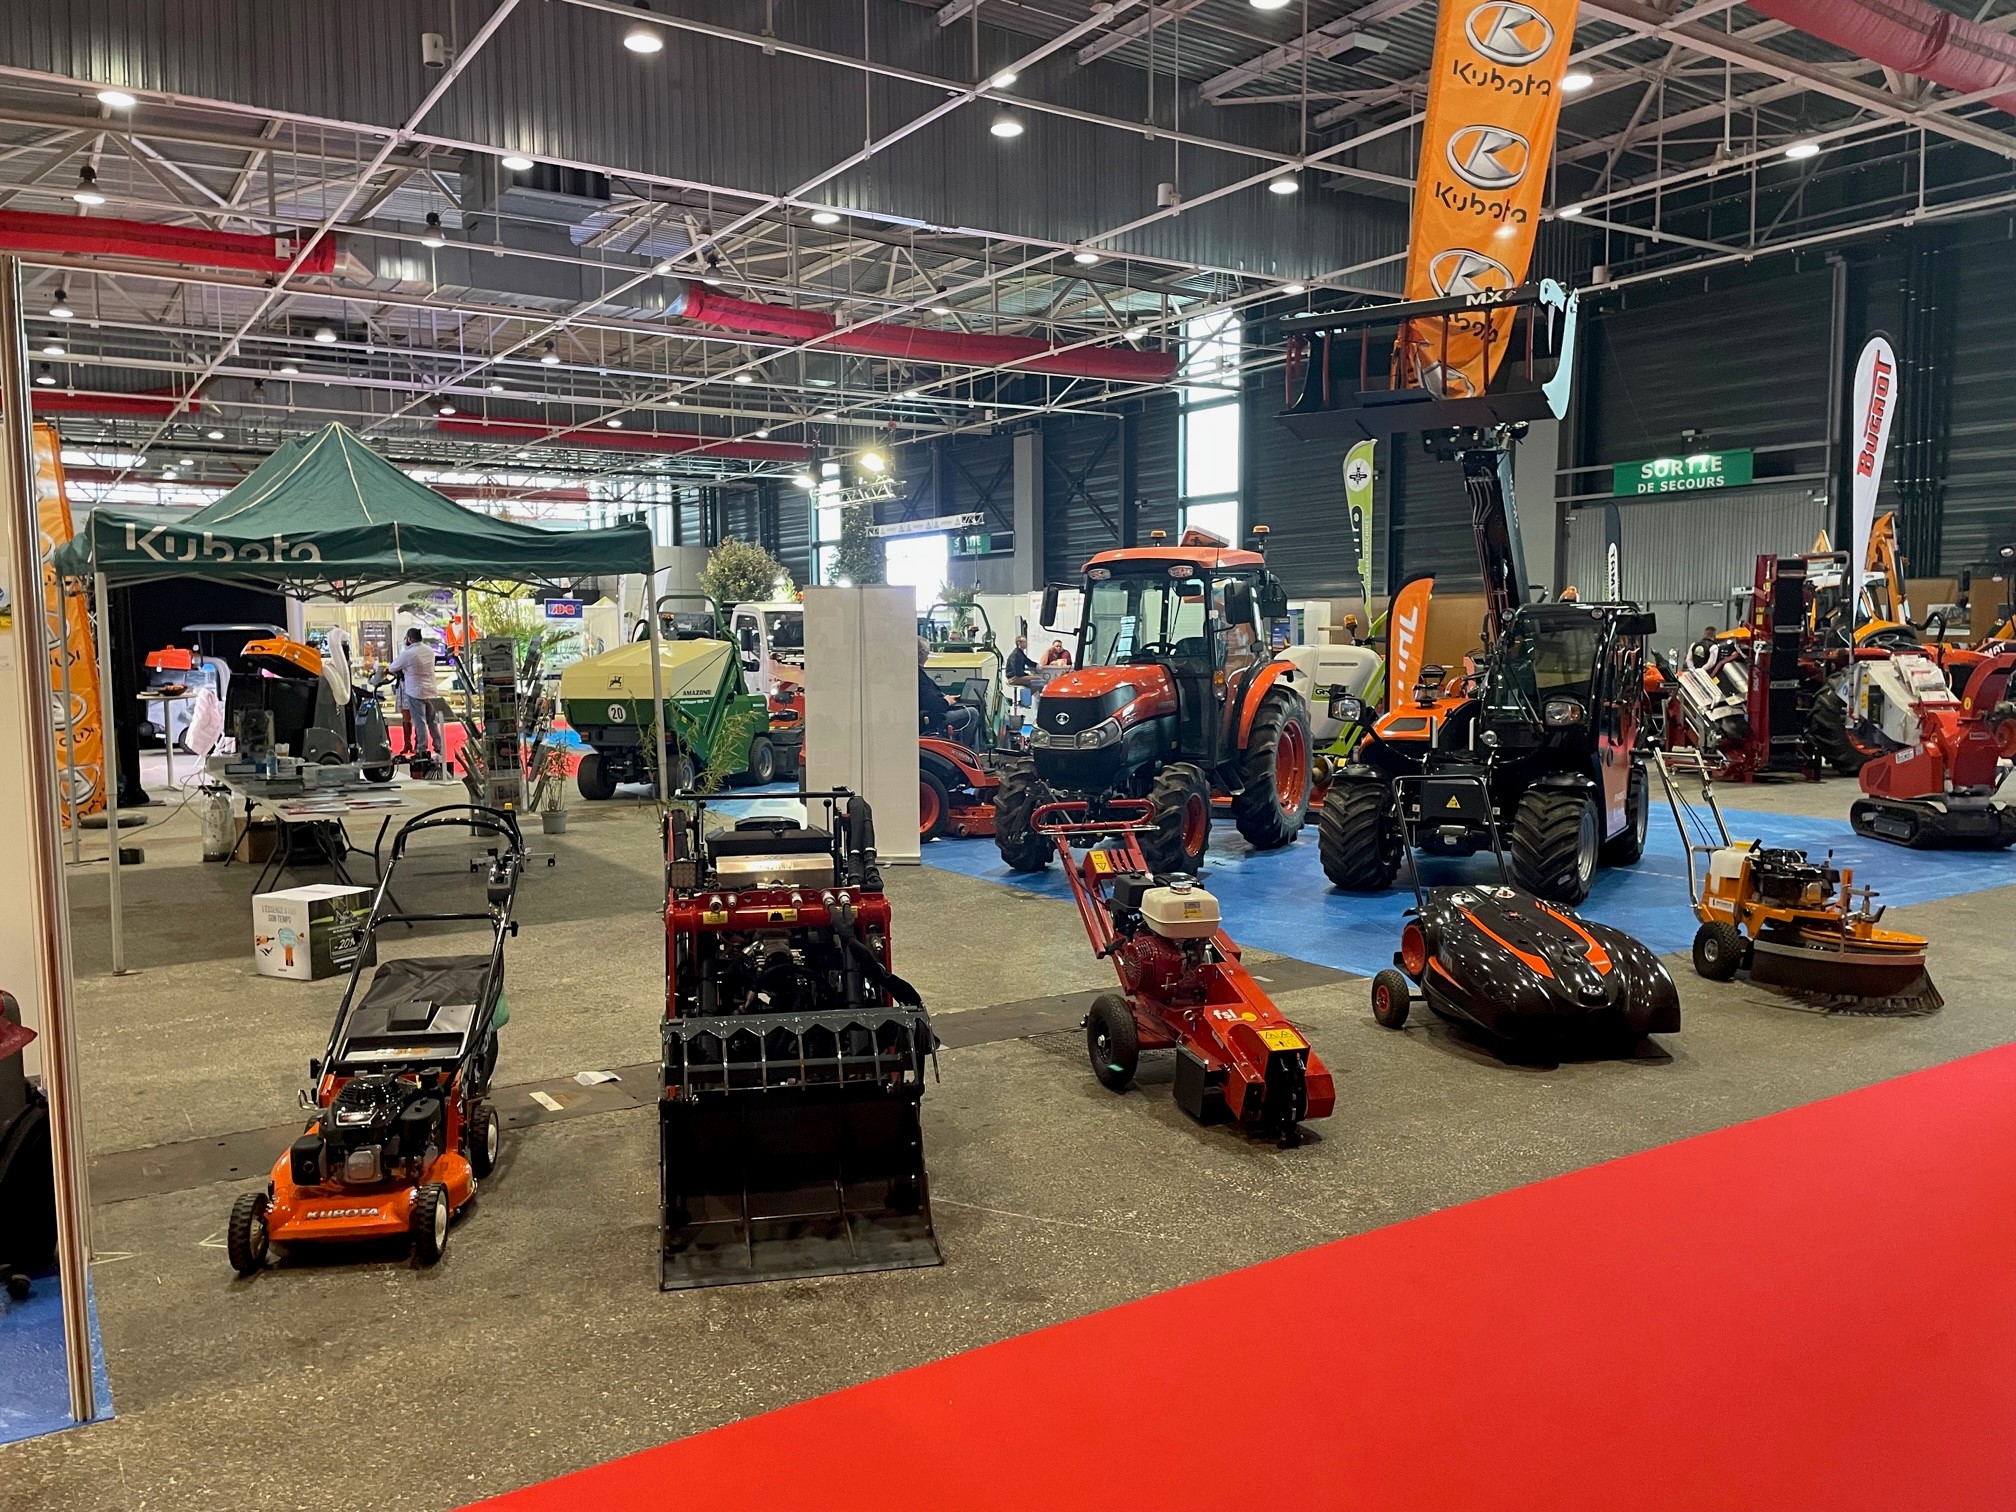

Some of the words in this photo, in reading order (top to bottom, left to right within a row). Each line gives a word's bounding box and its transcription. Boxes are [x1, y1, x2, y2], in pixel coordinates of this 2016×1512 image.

[1452, 59, 1552, 97] Kubota
[1435, 182, 1528, 224] Kubota
[1466, 290, 1503, 306] MX
[1857, 350, 1892, 478] BUGNOT
[1641, 456, 1723, 480] SORTIE
[1637, 482, 1655, 494] DE
[1660, 475, 1725, 493] SECOURS
[125, 523, 322, 563] Kubota
[610, 707, 624, 720] 20
[305, 1207, 379, 1220] KUBOTA
